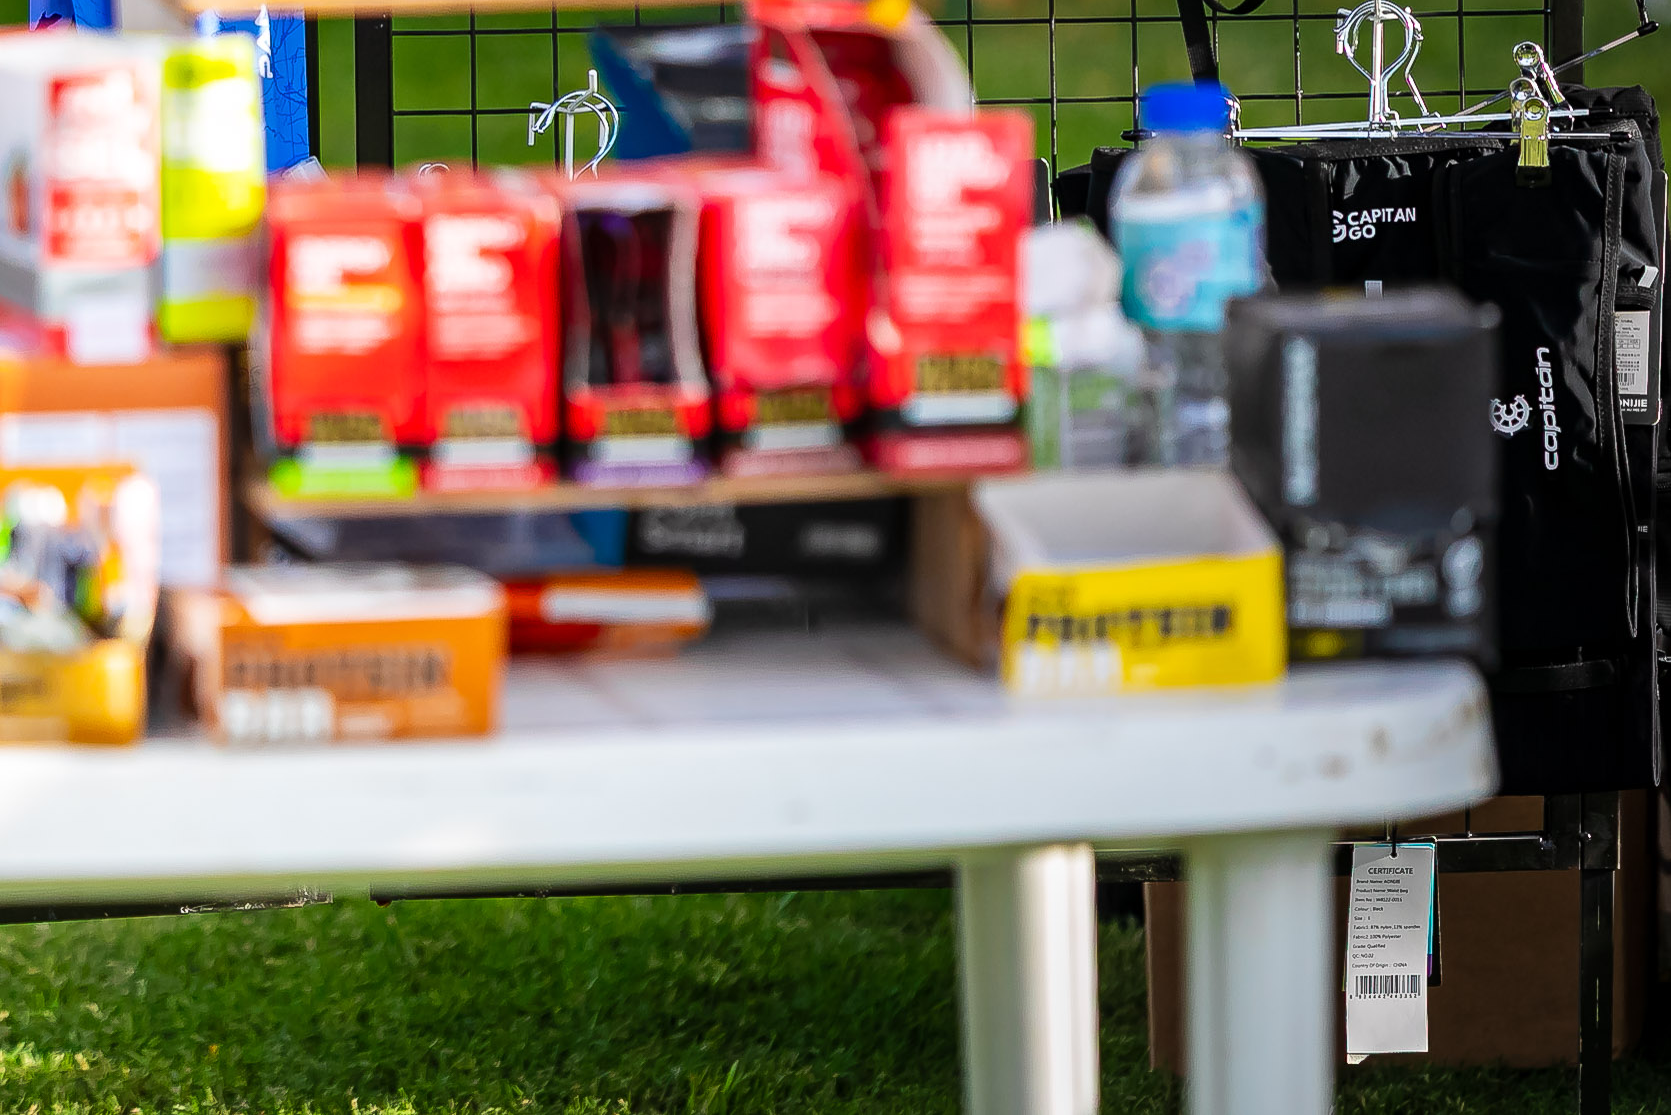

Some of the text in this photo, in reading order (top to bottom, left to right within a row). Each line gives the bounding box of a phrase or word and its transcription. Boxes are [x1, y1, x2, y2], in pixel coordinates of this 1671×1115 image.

[1347, 207, 1416, 226] CAPITAN
[1348, 224, 1376, 240] GO
[1535, 347, 1562, 470] capitán
[1620, 398, 1648, 408] NIJIE
[1367, 867, 1414, 875] CERTIFICATE
